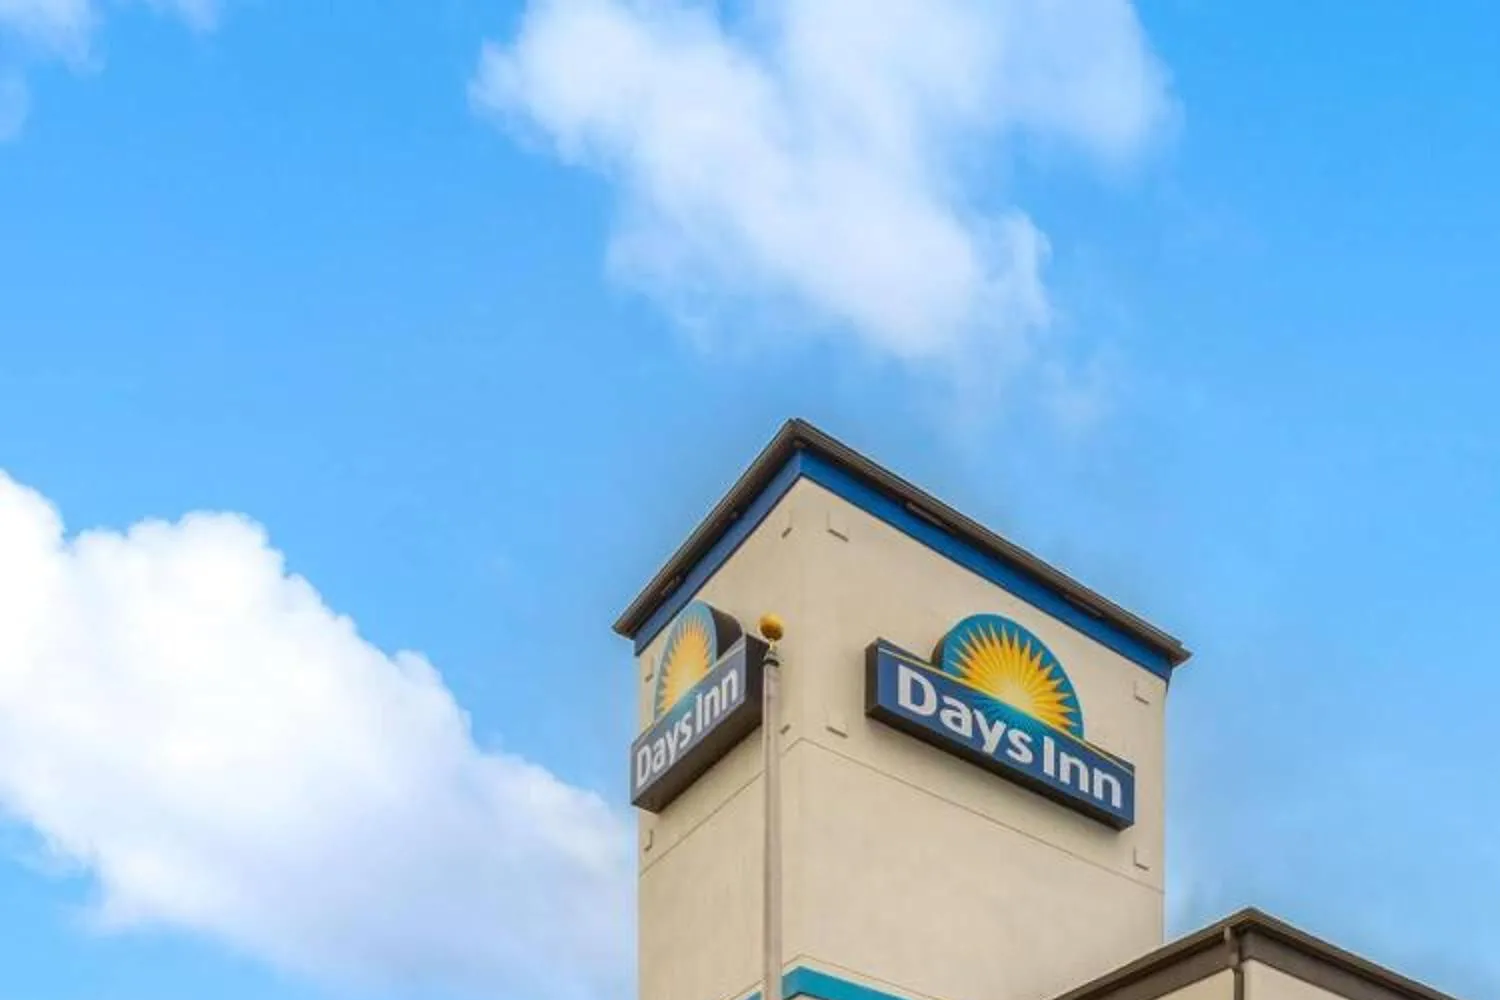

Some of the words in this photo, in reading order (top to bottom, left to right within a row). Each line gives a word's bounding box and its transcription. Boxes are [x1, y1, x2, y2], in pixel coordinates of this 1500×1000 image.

[636, 711, 693, 788] Days
[696, 668, 739, 733] Inn
[897, 664, 1033, 764] Days
[1043, 735, 1122, 809] Inn
